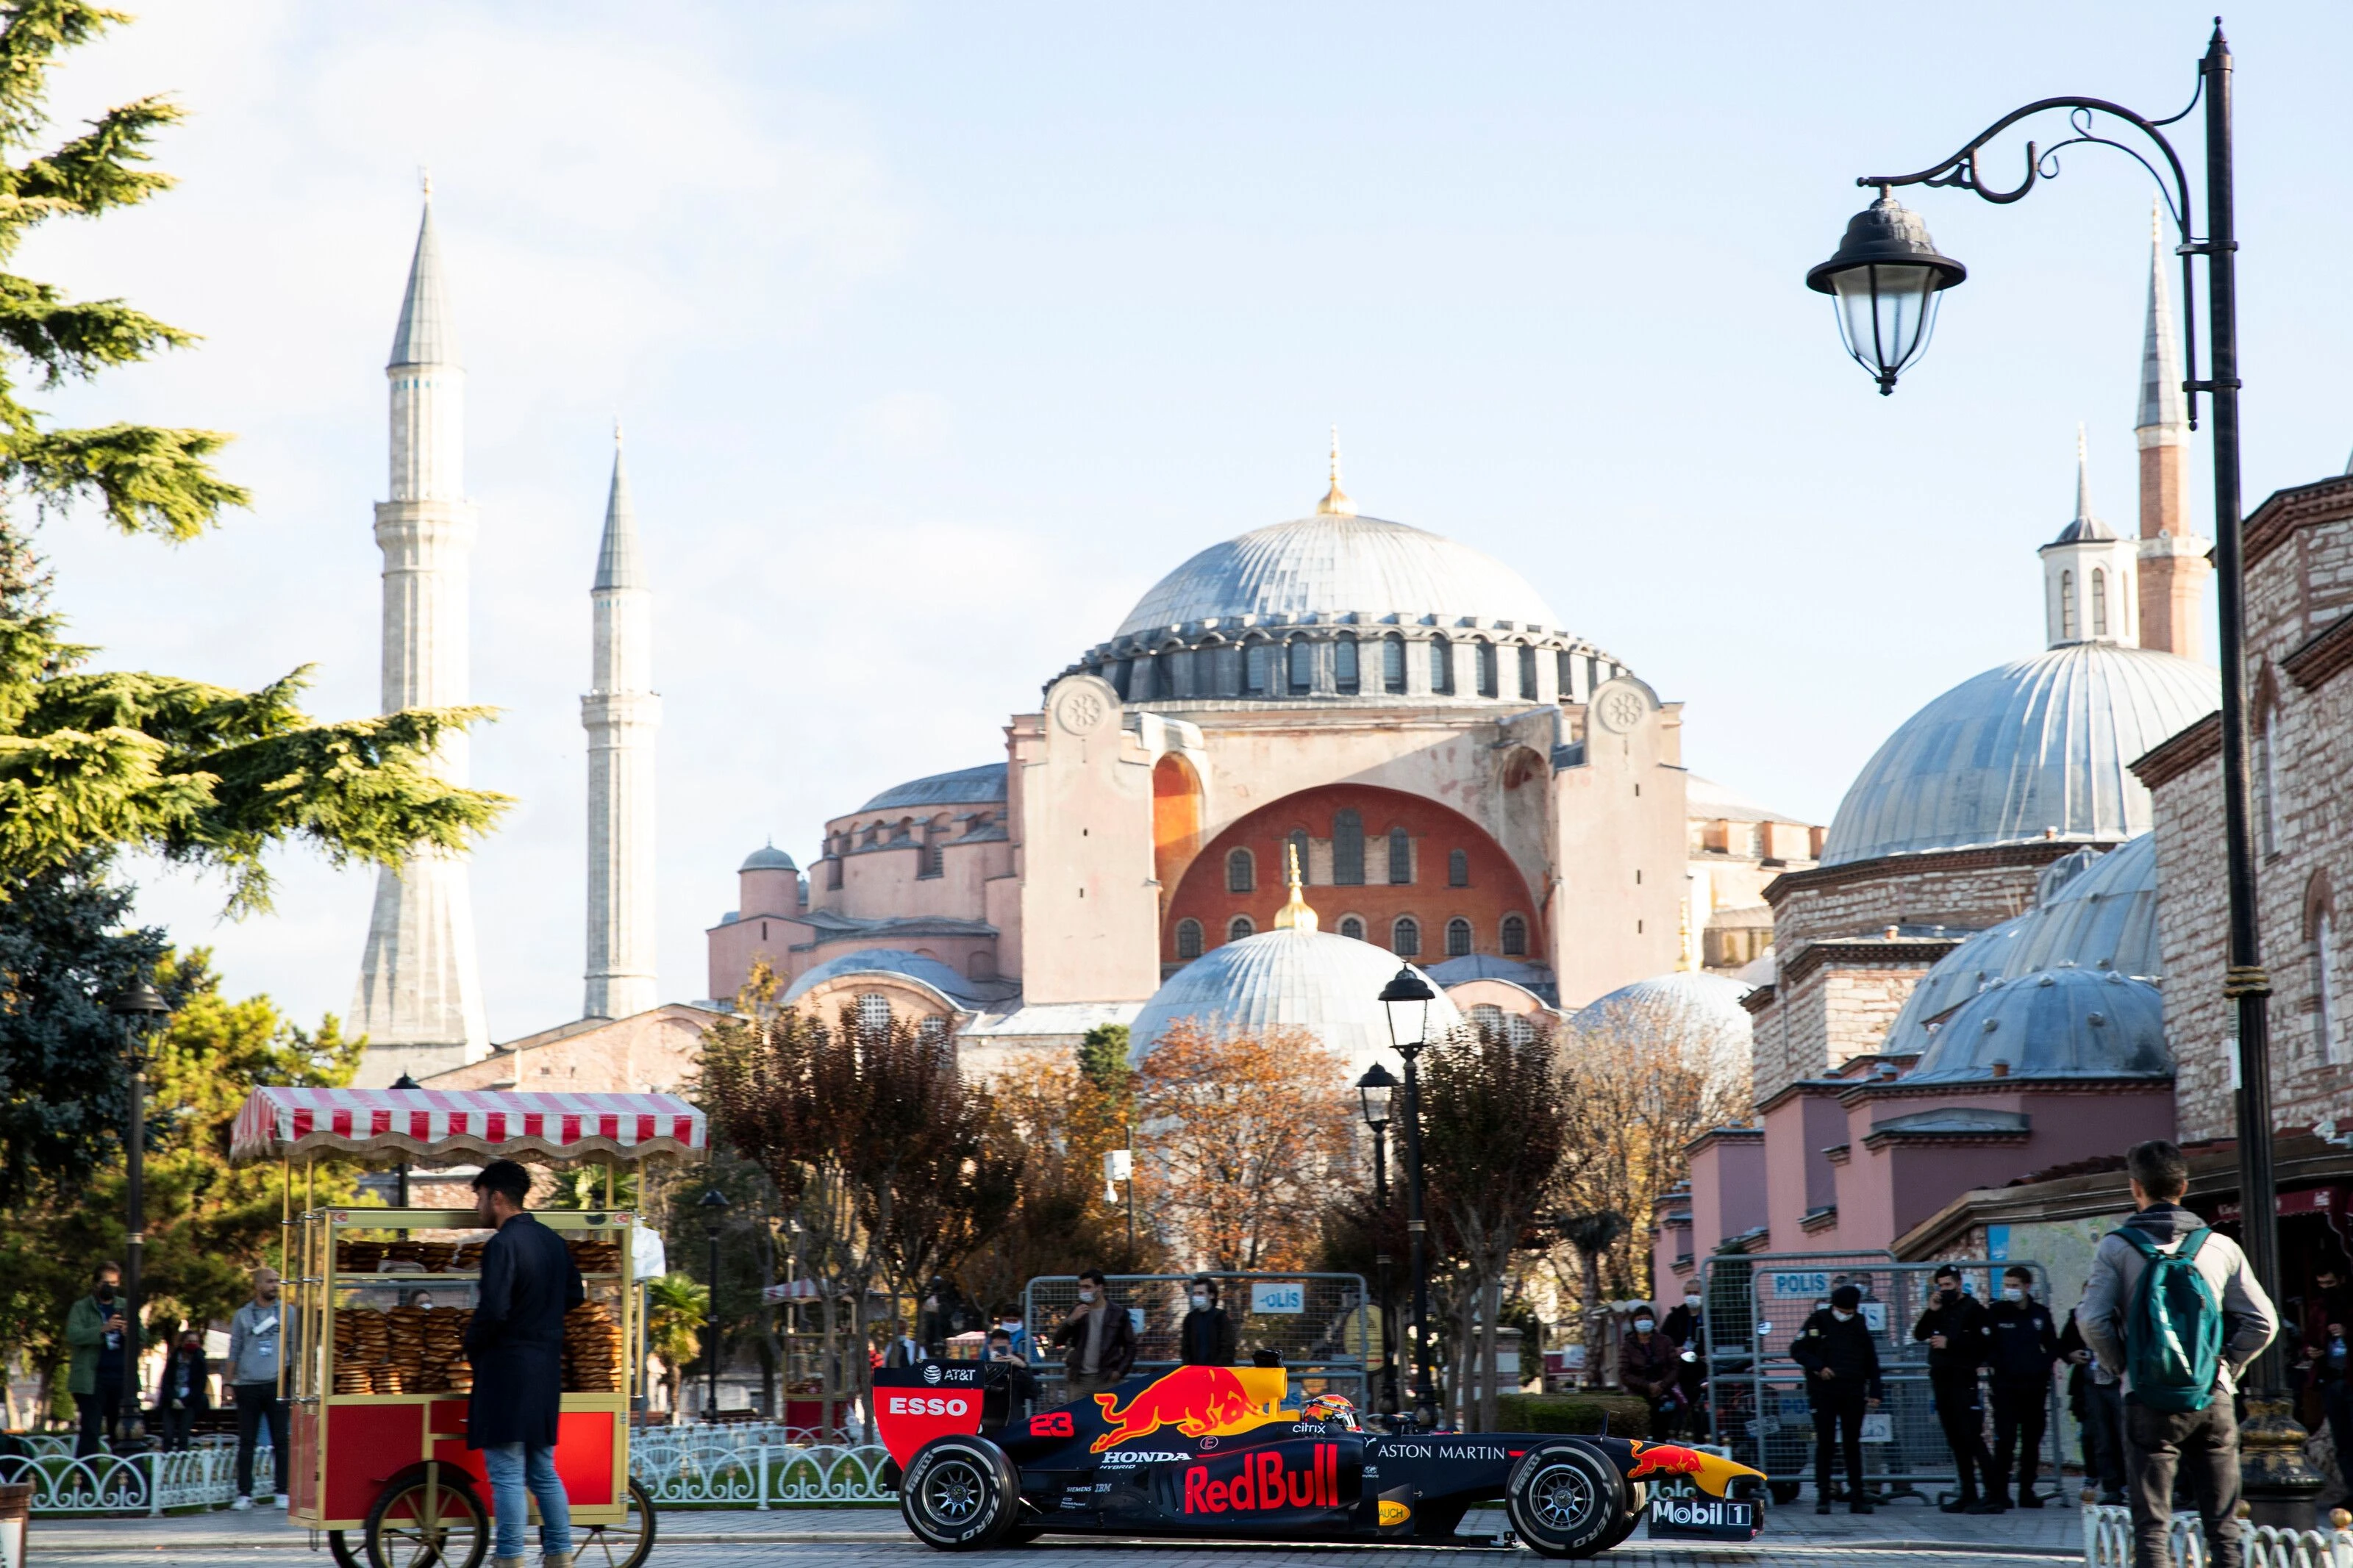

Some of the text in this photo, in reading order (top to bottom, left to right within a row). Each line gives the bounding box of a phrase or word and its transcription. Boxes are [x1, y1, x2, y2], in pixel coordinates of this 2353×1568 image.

[943, 1369, 976, 1381] AT&T
[889, 1397, 968, 1417] ESSO
[1029, 1411, 1074, 1437] 23
[1292, 1422, 1326, 1433] citrix
[1101, 1452, 1192, 1464] HONDA
[1378, 1445, 1505, 1460] ASTON MARTIN
[905, 1451, 935, 1494] PIRELLI
[1094, 1483, 1112, 1492] IBM
[961, 1494, 1000, 1541] ZERO
[1379, 1508, 1404, 1518] AUCH
[1652, 1501, 1722, 1525] Mobil
[1572, 1501, 1613, 1548] ZERO
